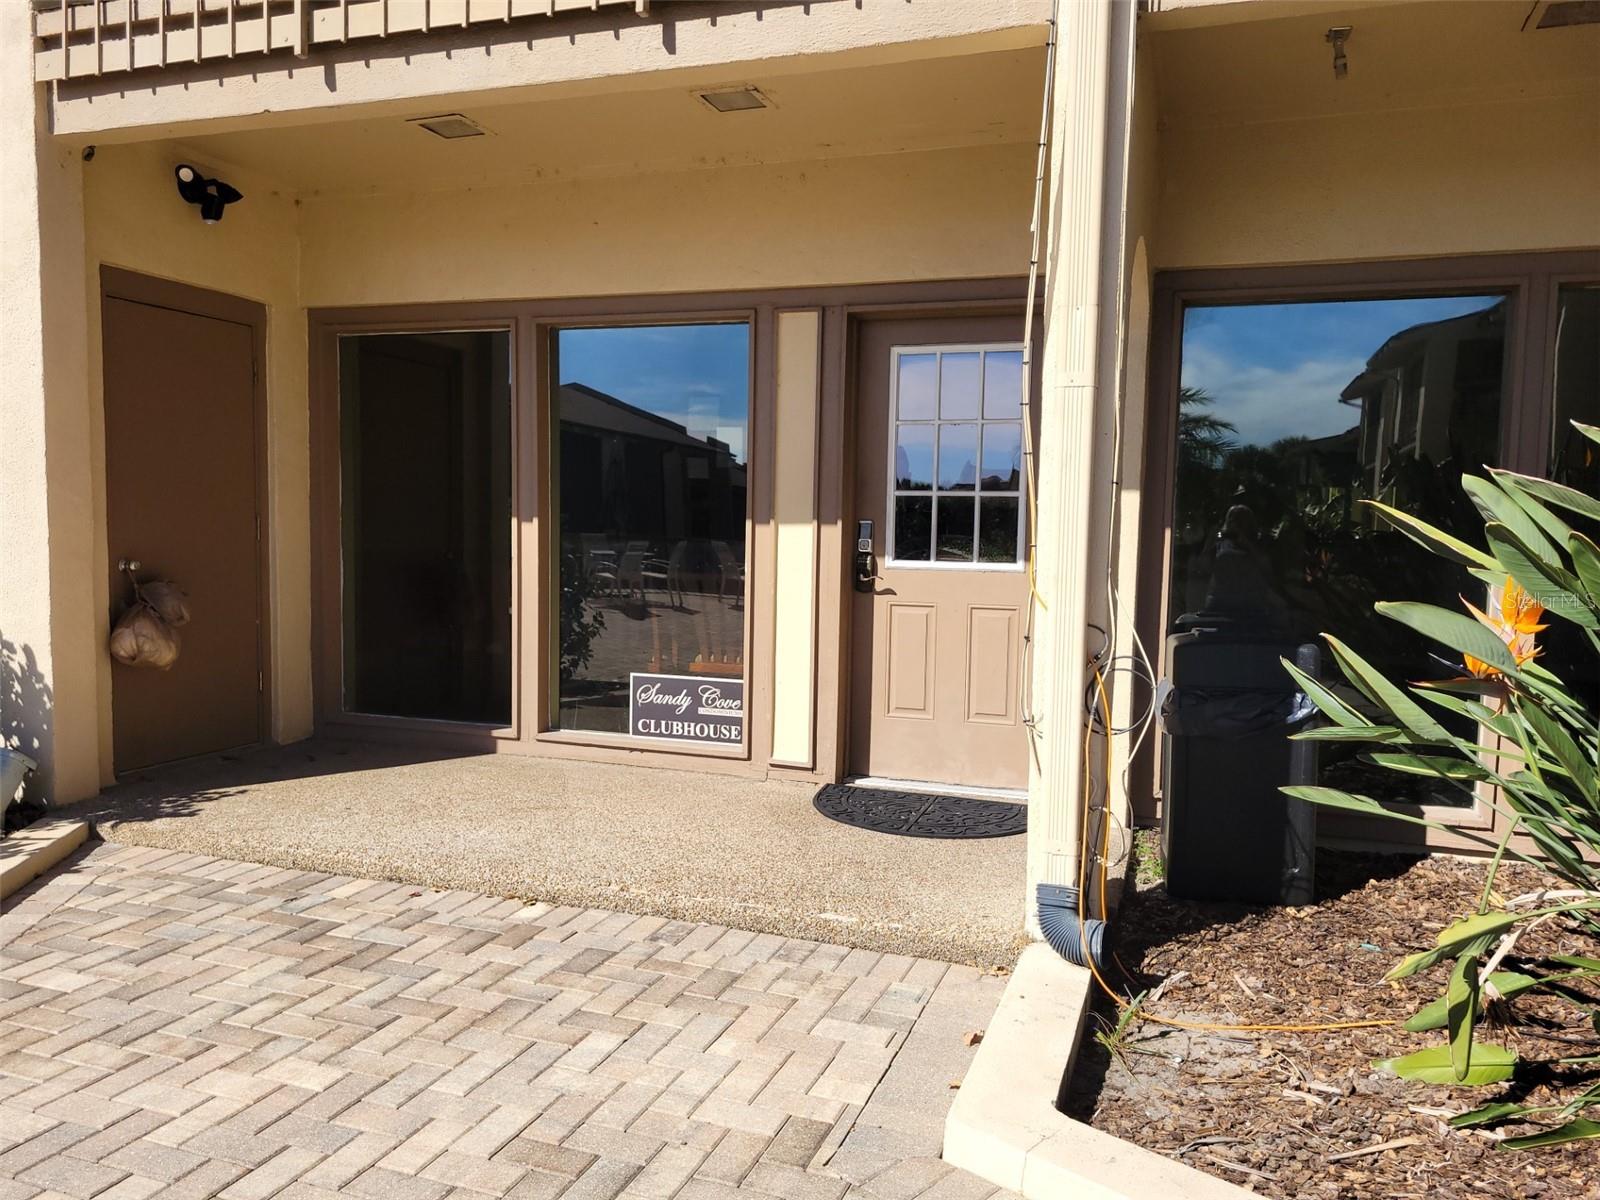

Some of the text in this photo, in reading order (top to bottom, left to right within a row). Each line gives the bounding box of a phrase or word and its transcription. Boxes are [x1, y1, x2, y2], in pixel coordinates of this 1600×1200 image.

[637, 683, 741, 715] Sandy Cove
[637, 718, 741, 740] CLUBHOUSE
